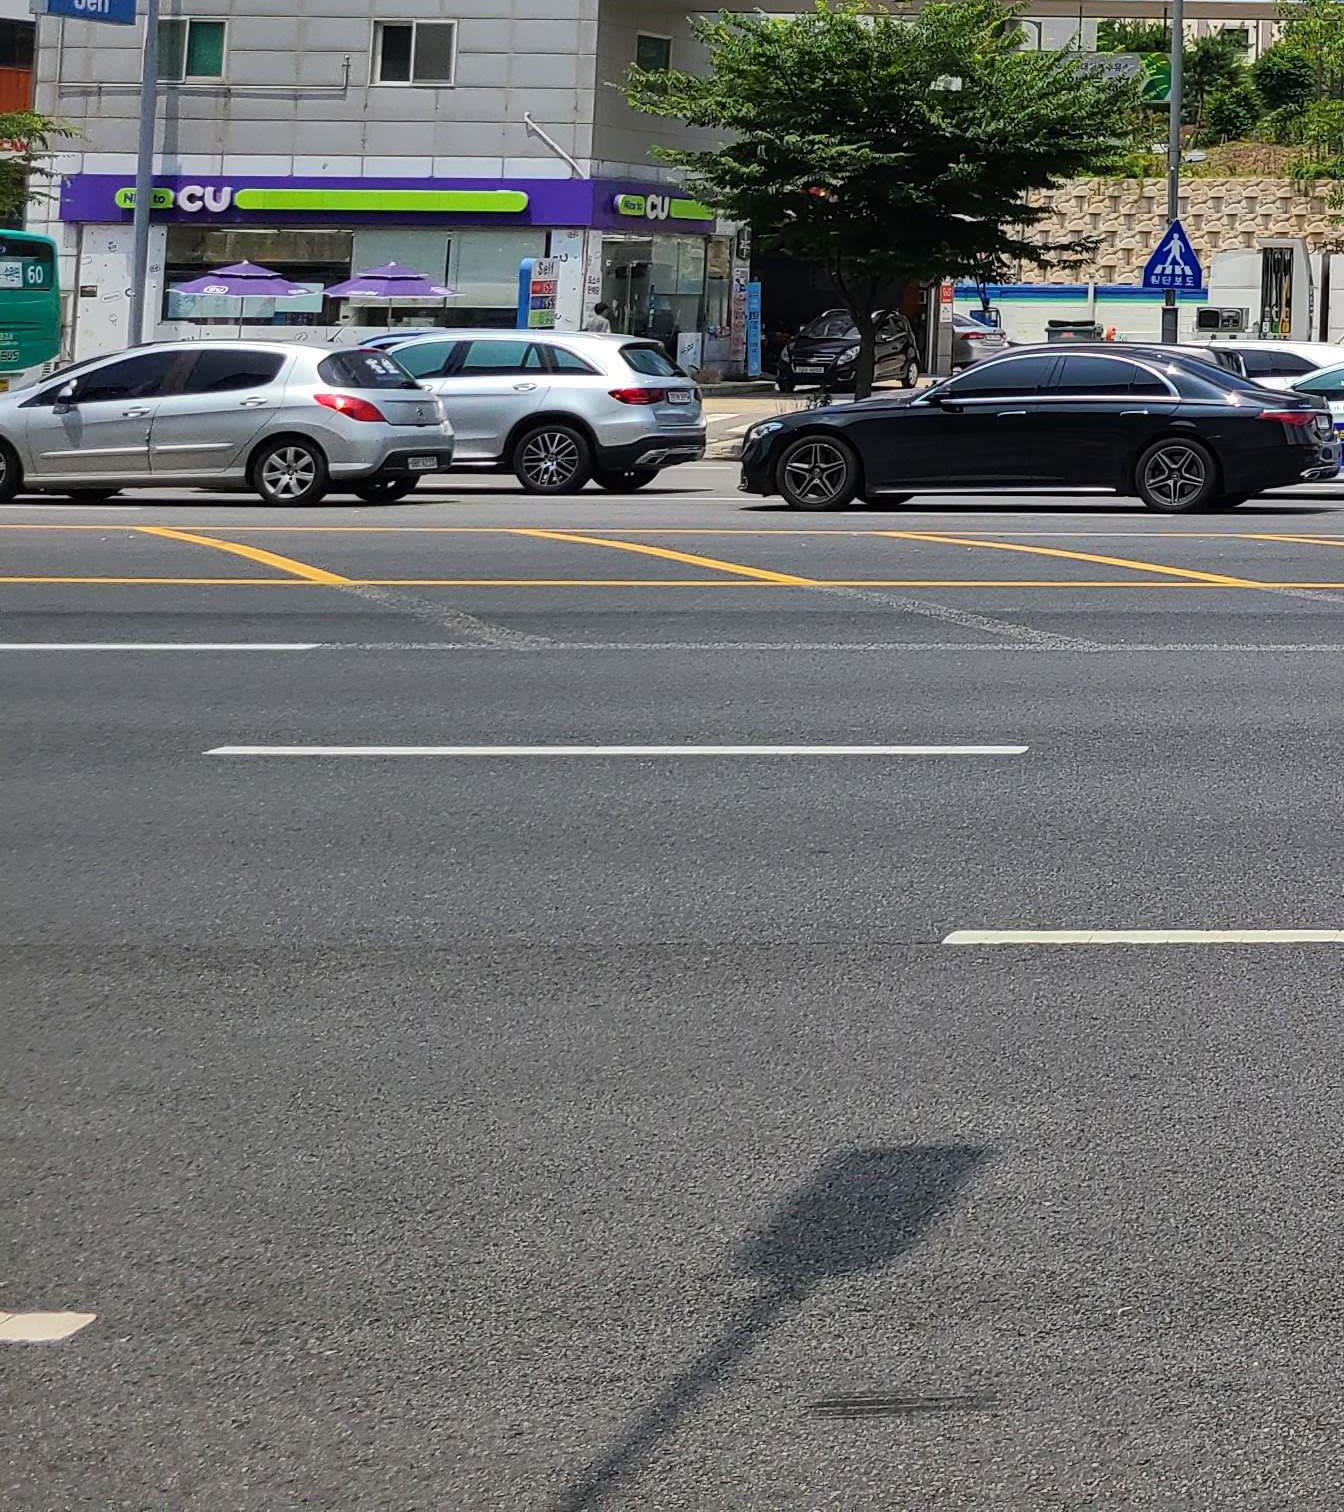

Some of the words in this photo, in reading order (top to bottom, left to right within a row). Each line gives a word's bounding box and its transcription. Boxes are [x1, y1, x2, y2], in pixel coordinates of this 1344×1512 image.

[153, 193, 165, 203] to
[178, 185, 234, 213] CU
[646, 194, 670, 220] CU
[27, 265, 44, 284] 60
